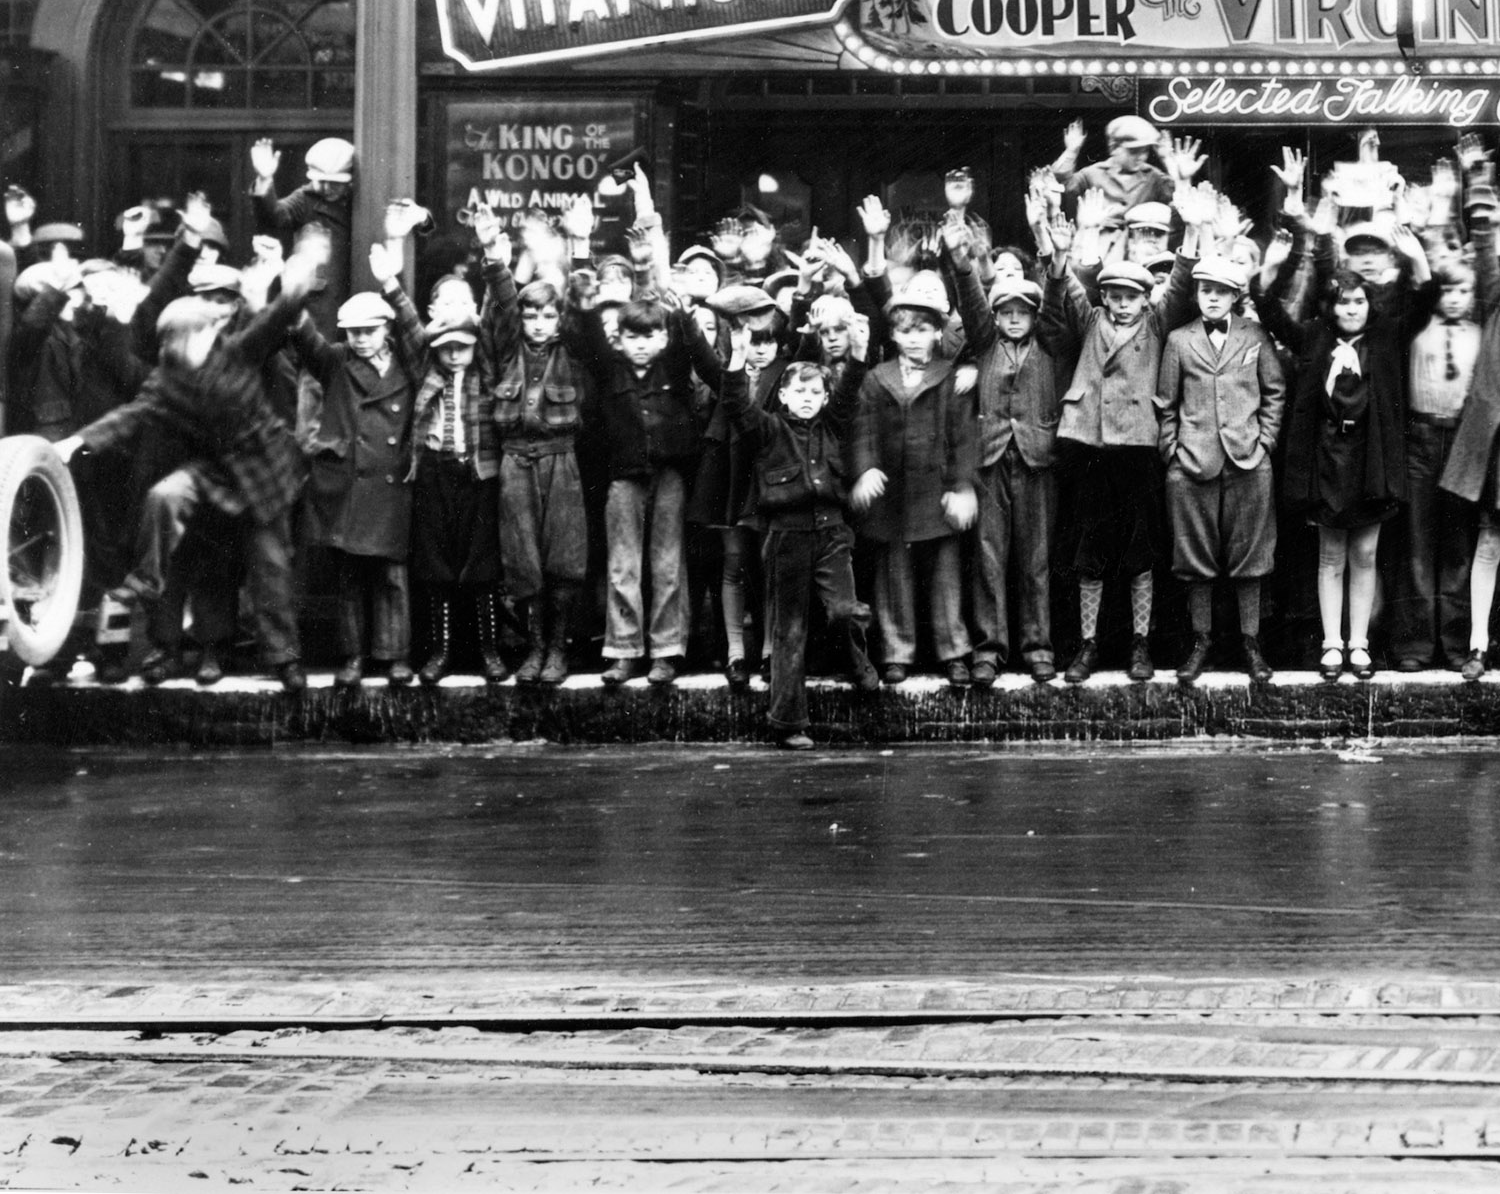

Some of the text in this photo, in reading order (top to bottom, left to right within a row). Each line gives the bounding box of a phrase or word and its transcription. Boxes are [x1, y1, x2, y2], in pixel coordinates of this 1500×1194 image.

[1149, 77, 1322, 123] Selected
[1323, 75, 1490, 127] Talking
[499, 123, 574, 150] KING
[585, 123, 607, 137] OF
[582, 136, 611, 149] THE
